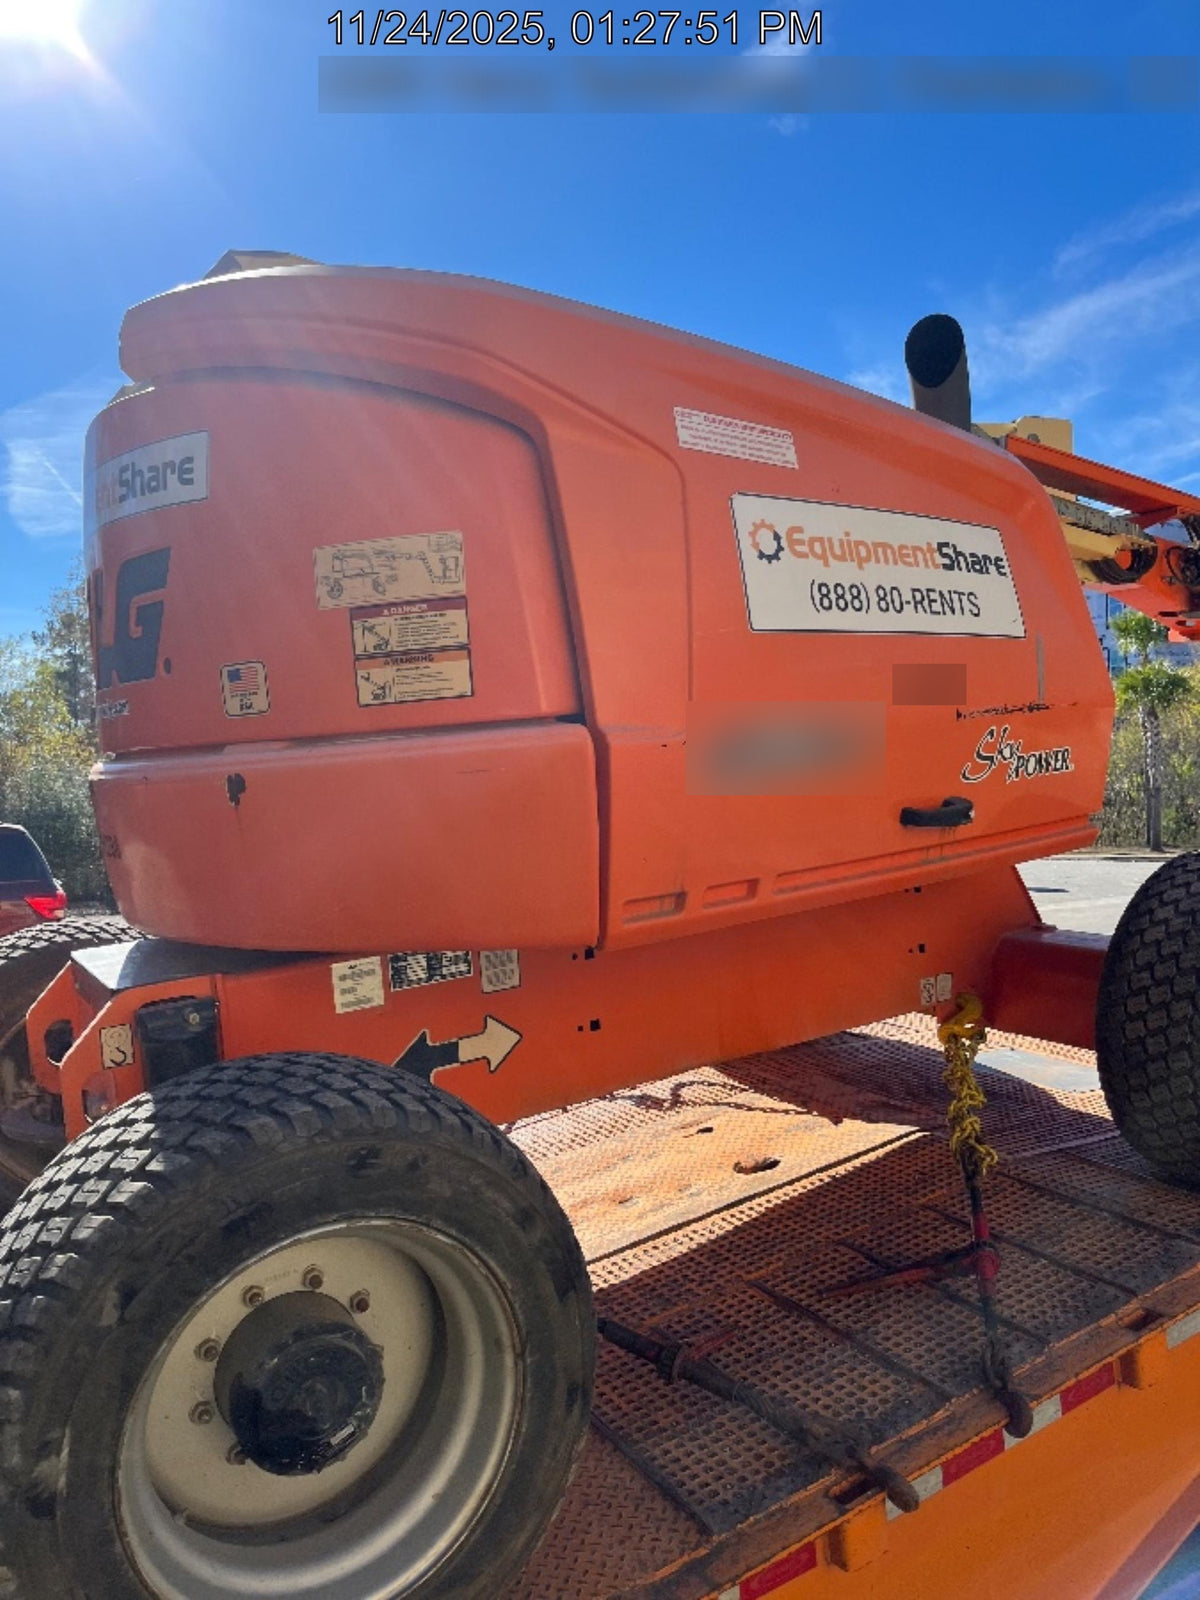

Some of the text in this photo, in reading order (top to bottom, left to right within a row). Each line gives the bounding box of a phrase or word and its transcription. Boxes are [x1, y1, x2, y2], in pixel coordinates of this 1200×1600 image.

[785, 525, 1007, 577] EquipmentShare
[810, 579, 981, 617] (888) 80-RENTS
